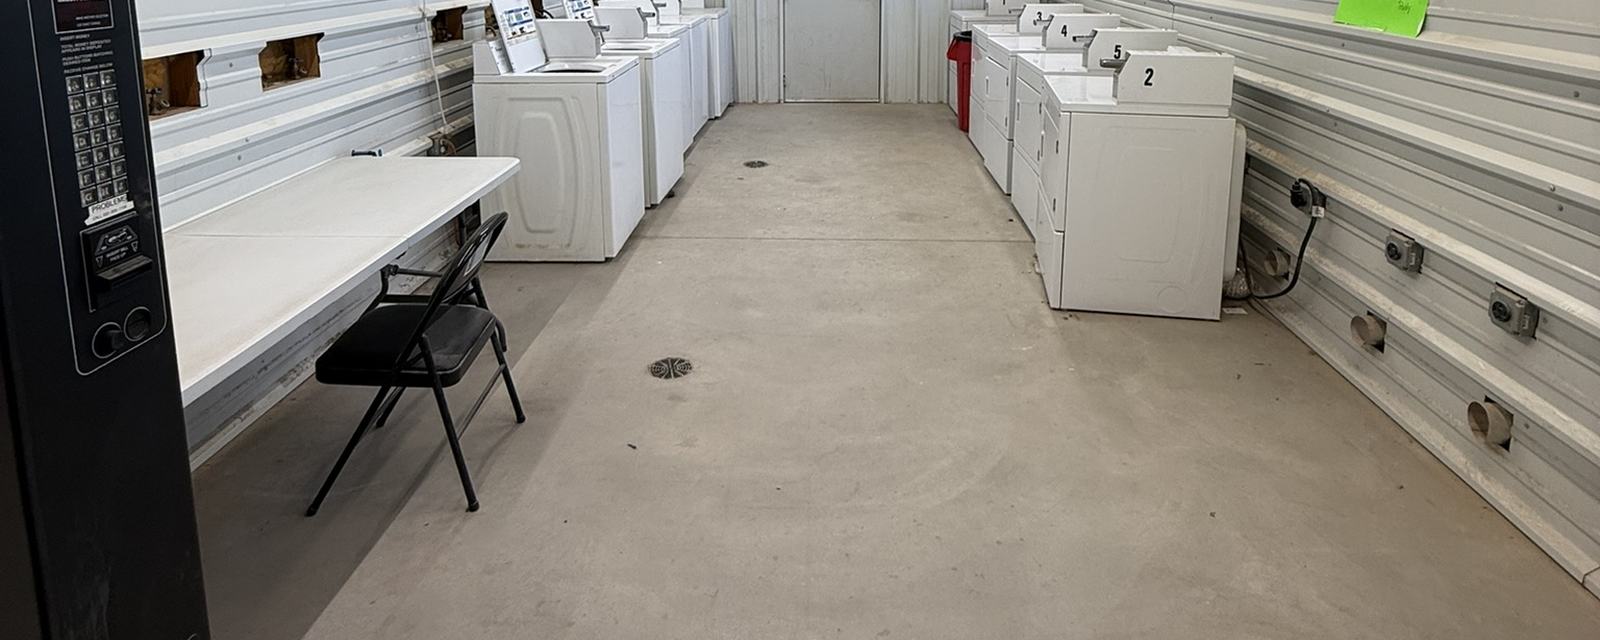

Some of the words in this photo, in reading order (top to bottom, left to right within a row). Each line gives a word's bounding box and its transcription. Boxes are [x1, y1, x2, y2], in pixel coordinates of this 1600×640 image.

[1037, 12, 1043, 21] 3
[1061, 25, 1067, 37] 4
[1113, 45, 1122, 59] 5
[1144, 68, 1154, 86] 2
